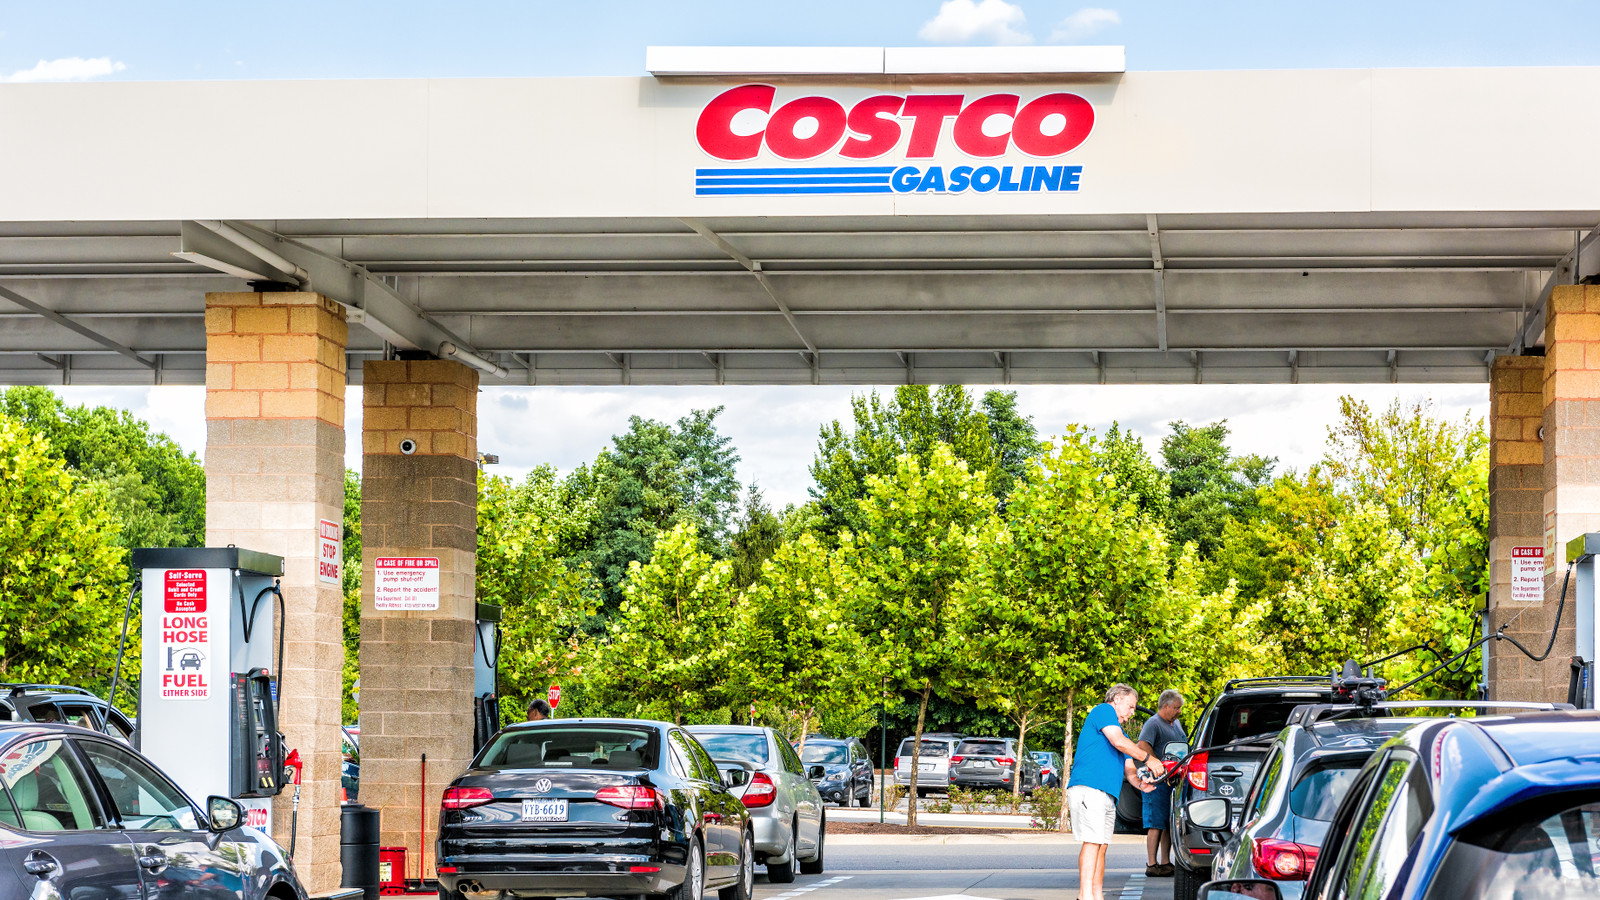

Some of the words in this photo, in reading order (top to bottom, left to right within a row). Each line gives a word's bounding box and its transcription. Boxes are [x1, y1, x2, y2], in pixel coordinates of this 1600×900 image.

[695, 84, 1096, 161] COSTCO
[891, 165, 1083, 192] GASOLINE
[323, 543, 336, 559] STOP
[320, 561, 338, 578] ENGINE
[163, 617, 207, 628] LONG
[163, 631, 207, 643] HOSE
[163, 674, 207, 687] FUEL
[550, 690, 559, 700] STOP
[525, 804, 564, 815] VYB-6619
[247, 808, 267, 826] STCO
